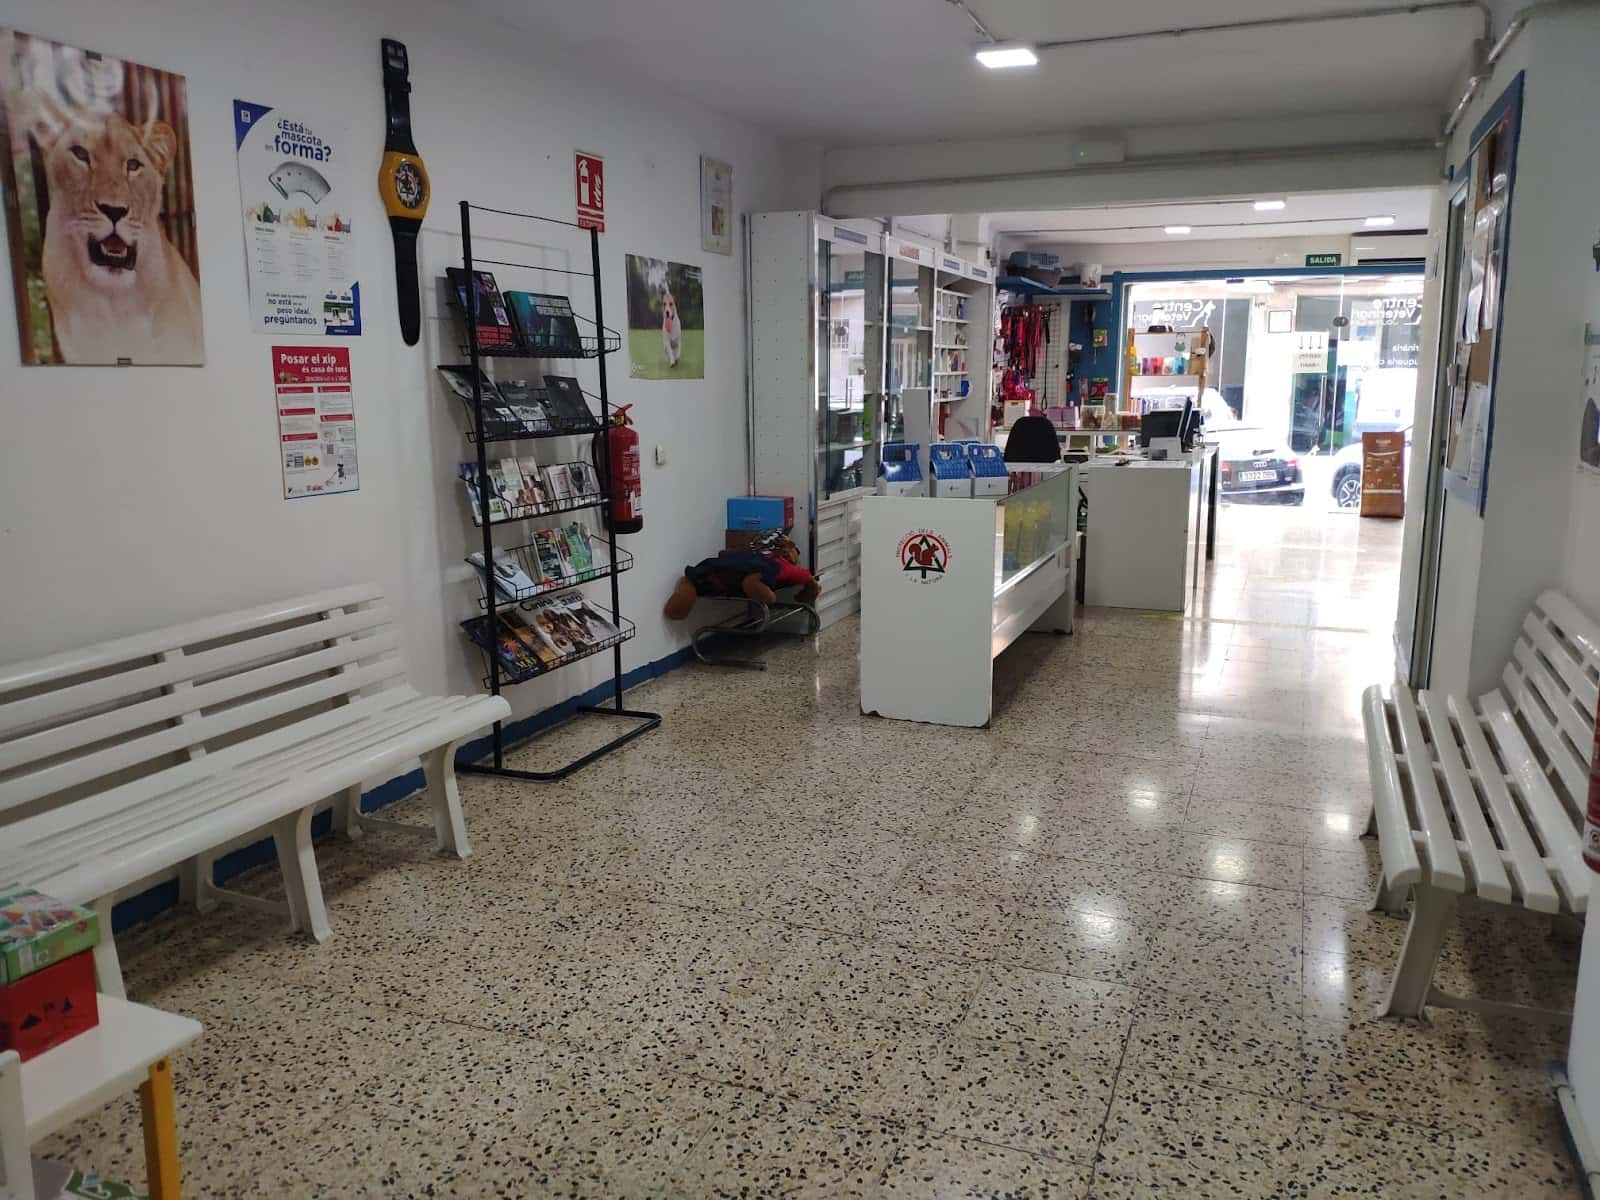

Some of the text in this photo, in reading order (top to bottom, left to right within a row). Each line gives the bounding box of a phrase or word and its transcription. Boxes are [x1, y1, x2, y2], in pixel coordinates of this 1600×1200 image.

[277, 119, 304, 134] ¿Está
[281, 130, 322, 146] mascota
[274, 135, 332, 162] forma?
[1309, 255, 1337, 264] SALIDA
[264, 315, 317, 325] pregúntanos
[280, 353, 336, 367] Posar el xip
